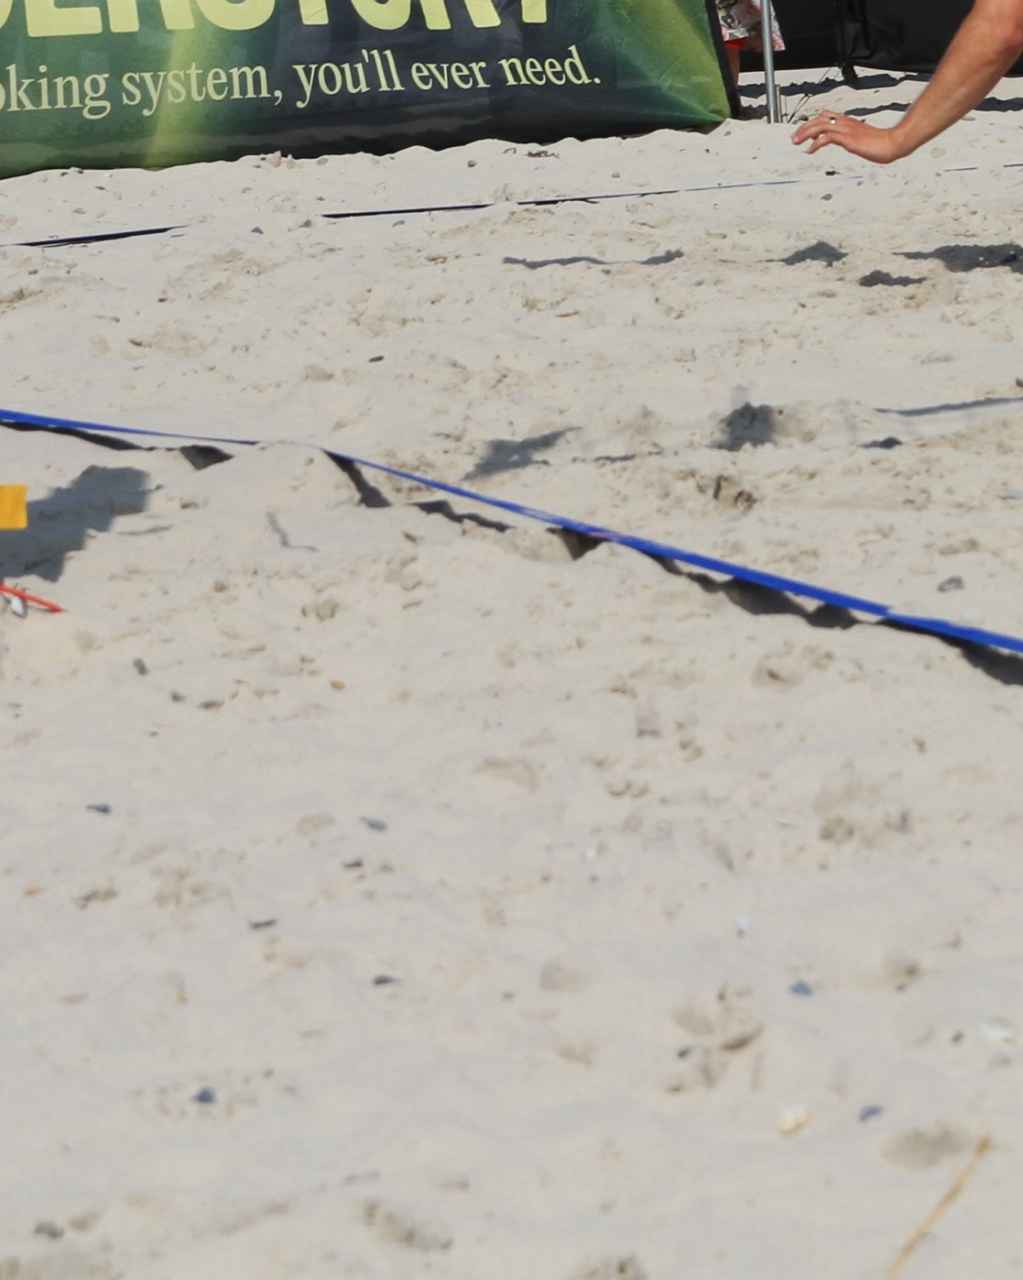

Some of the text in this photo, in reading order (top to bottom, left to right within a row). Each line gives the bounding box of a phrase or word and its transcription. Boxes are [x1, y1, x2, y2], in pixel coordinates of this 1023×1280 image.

[121, 62, 283, 116] system,
[292, 49, 405, 108] you'll
[411, 60, 491, 90] ever
[498, 45, 601, 86] need.
